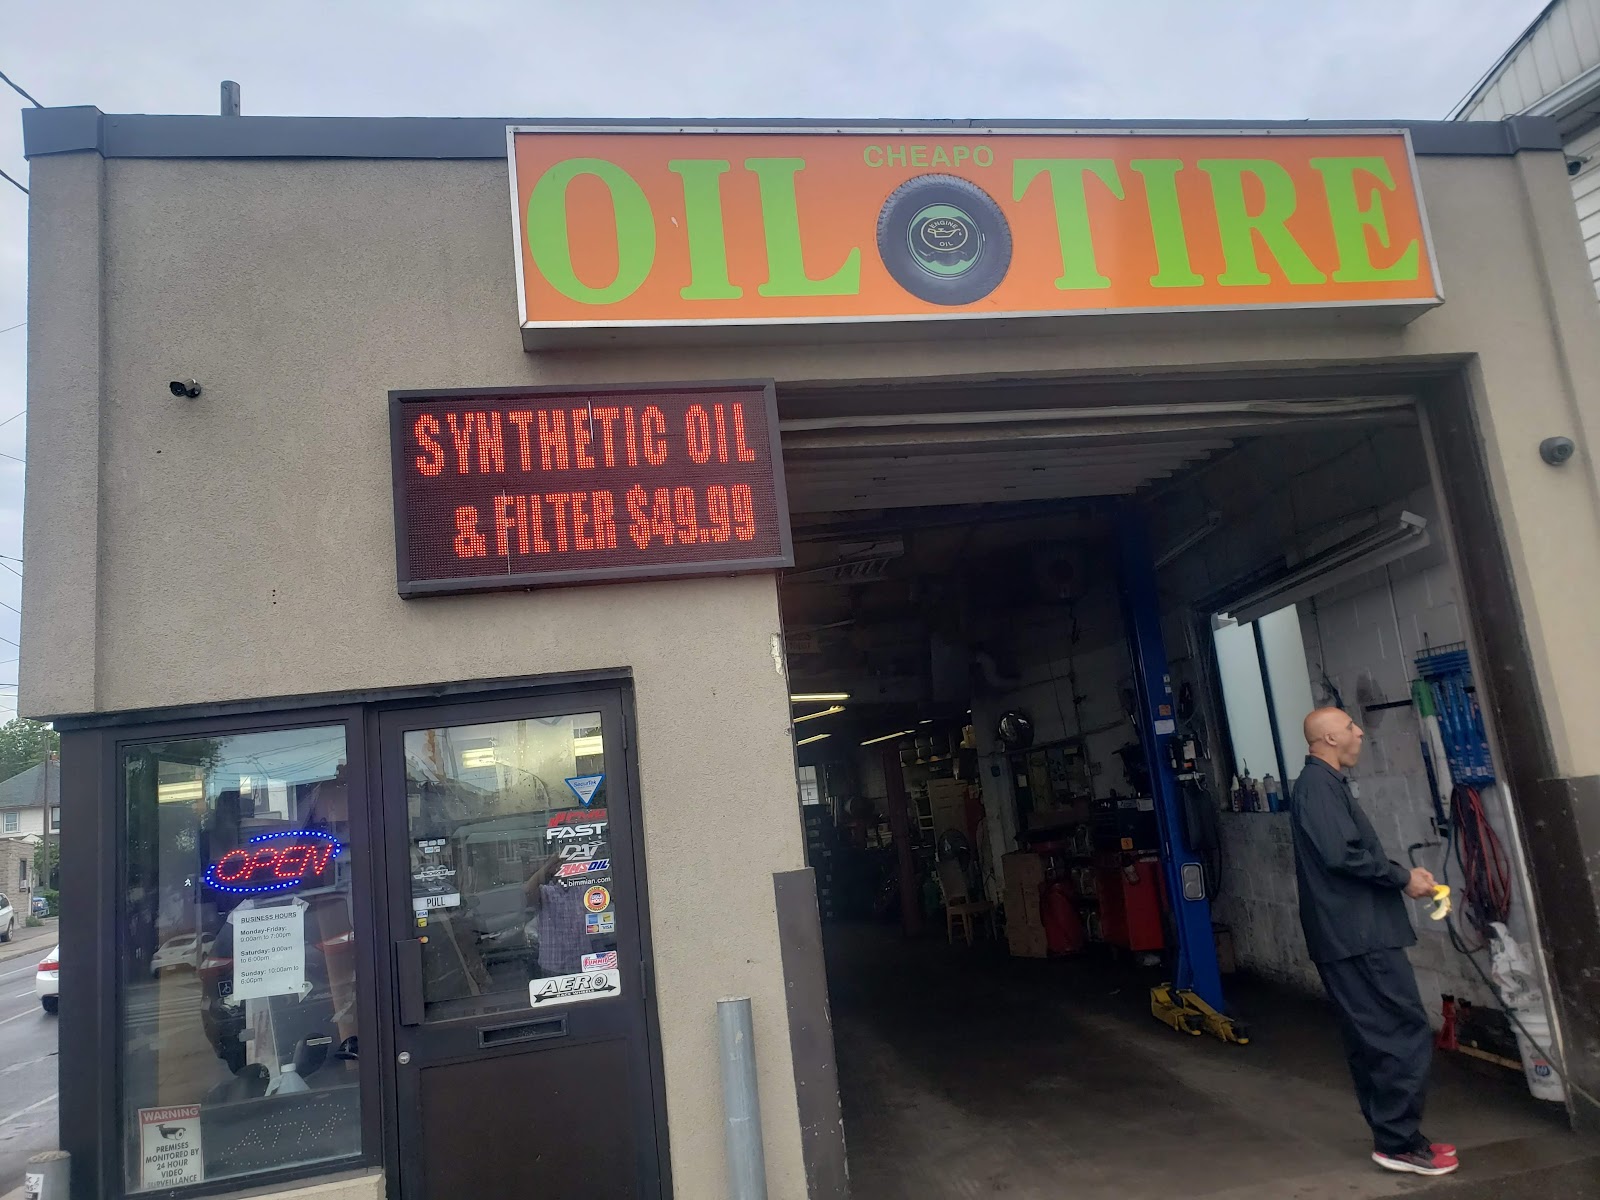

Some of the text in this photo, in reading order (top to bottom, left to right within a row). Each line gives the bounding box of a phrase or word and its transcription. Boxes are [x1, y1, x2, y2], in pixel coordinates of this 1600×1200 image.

[863, 144, 994, 168] CHEAPO
[527, 156, 1421, 305] OIL TIRE
[928, 219, 958, 231] ENGINE
[414, 402, 755, 476] SYNTHETIC OIL
[453, 483, 755, 558] & FILTER $49.99
[546, 822, 608, 840] FAST
[216, 844, 333, 881] OPEN
[555, 859, 609, 876] AMSOIL
[568, 876, 611, 887] bimmian.com
[426, 897, 446, 908] PULL
[241, 911, 297, 924] BUSINESS HOURS
[240, 925, 287, 935] Monday-Friday:
[241, 948, 270, 957] Saturday:
[241, 969, 266, 978] Sunday:
[268, 966, 292, 974] 10:00am
[538, 973, 608, 996] AERO
[143, 1107, 199, 1122] WARNING
[156, 1141, 189, 1153] PREMISES
[145, 1148, 200, 1164] MONITORED BY
[156, 1158, 188, 1171] 24 HOUR
[161, 1168, 184, 1178] VIDEO
[147, 1174, 197, 1188] SURVEILLANCE
